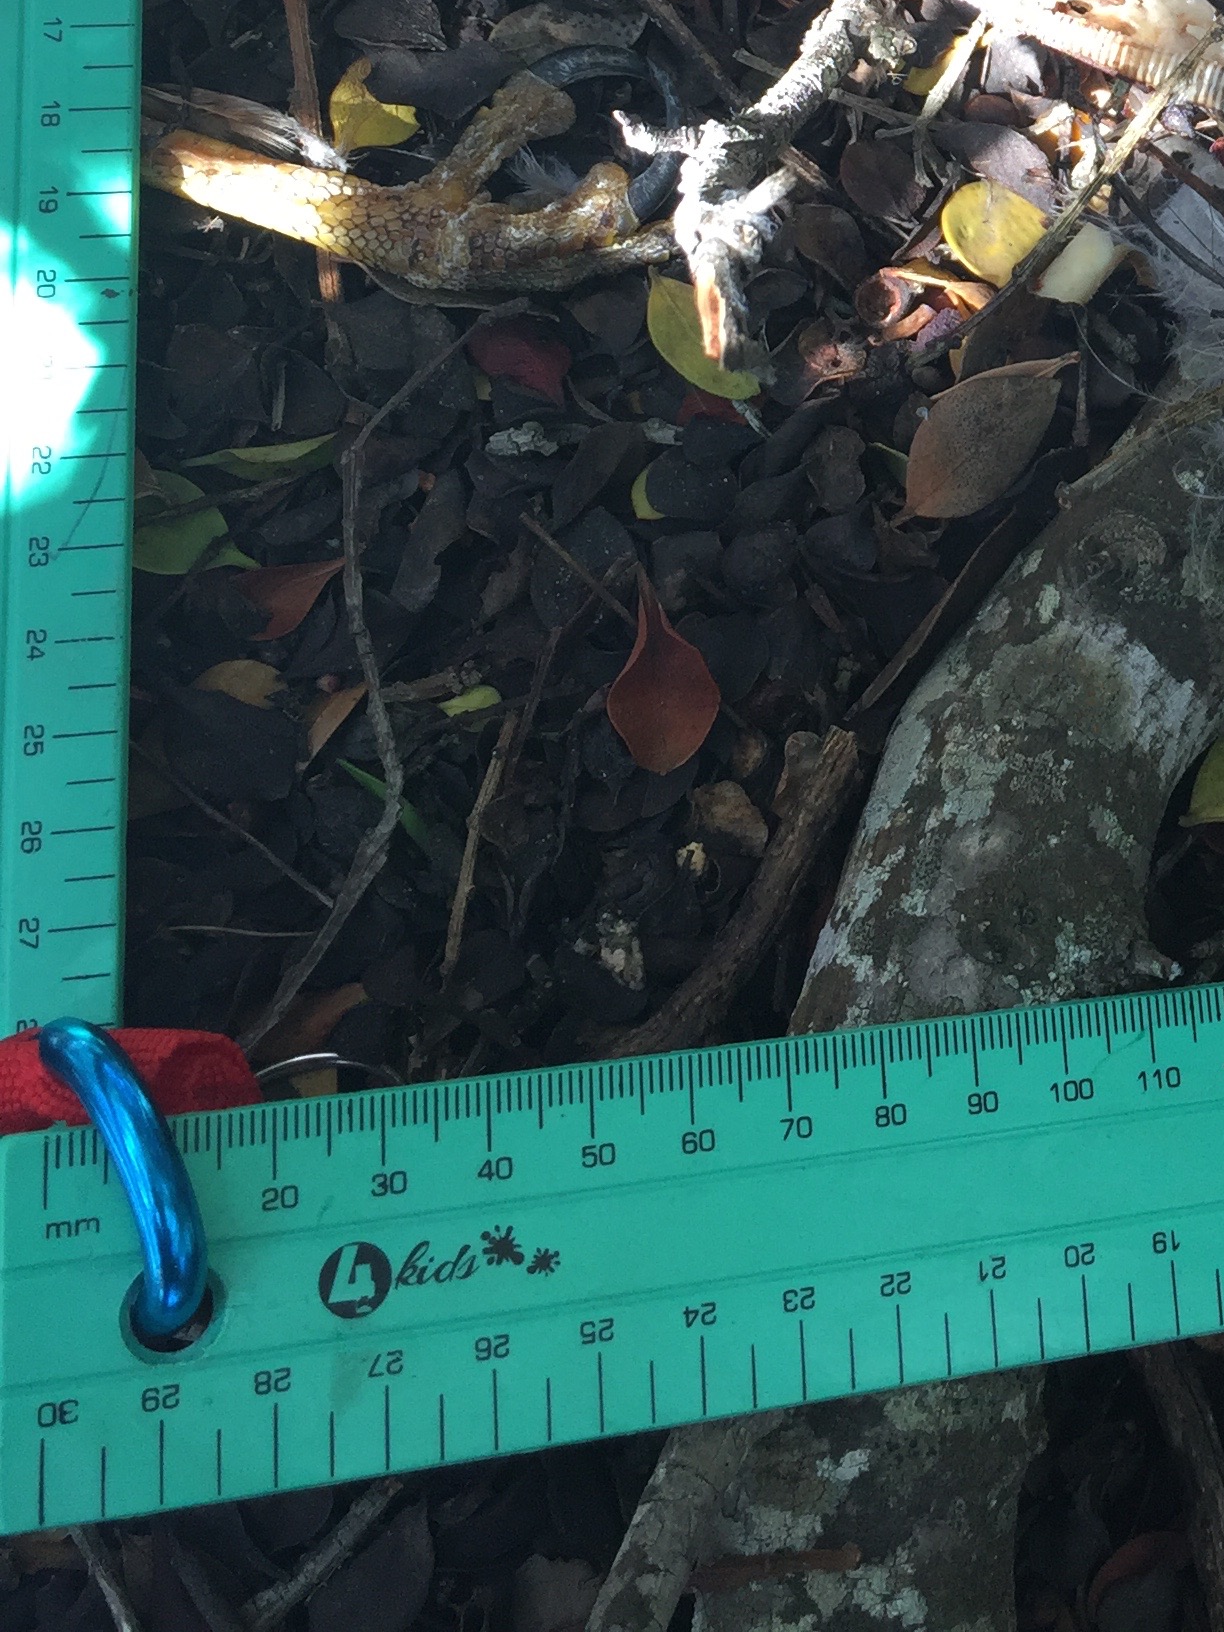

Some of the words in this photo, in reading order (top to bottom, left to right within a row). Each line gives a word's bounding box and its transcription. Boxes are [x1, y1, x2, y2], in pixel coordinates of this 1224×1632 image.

[43, 18, 62, 43] 17
[41, 100, 60, 127] 18
[39, 186, 58, 213] 19
[36, 270, 56, 298] 20
[32, 446, 52, 474] 22
[28, 537, 49, 567] 23
[26, 629, 46, 661] 24
[24, 725, 44, 756] 25
[21, 820, 42, 854] 26
[19, 918, 39, 948] 27
[45, 1217, 100, 1239] mm
[261, 1186, 299, 1211] 20
[371, 1172, 407, 1197] 30
[478, 1157, 514, 1181] 40
[581, 1143, 616, 1168] 50
[682, 1129, 716, 1154] 60
[781, 1116, 813, 1140] 70
[875, 1104, 907, 1128] 80
[968, 1091, 999, 1115] 90
[1050, 1078, 1094, 1104] 100
[1138, 1067, 1182, 1091] 110
[1064, 1243, 1095, 1267] 20
[1152, 1231, 1180, 1254] 19
[978, 1256, 1007, 1282] 21
[880, 1272, 912, 1296] 22
[783, 1287, 816, 1312] 23
[683, 1303, 717, 1328] 24
[580, 1319, 615, 1345] 25
[475, 1334, 510, 1360] 26
[368, 1350, 404, 1378] 27
[254, 1368, 292, 1395] 28
[142, 1385, 180, 1412] 29
[38, 1400, 79, 1427] 30
